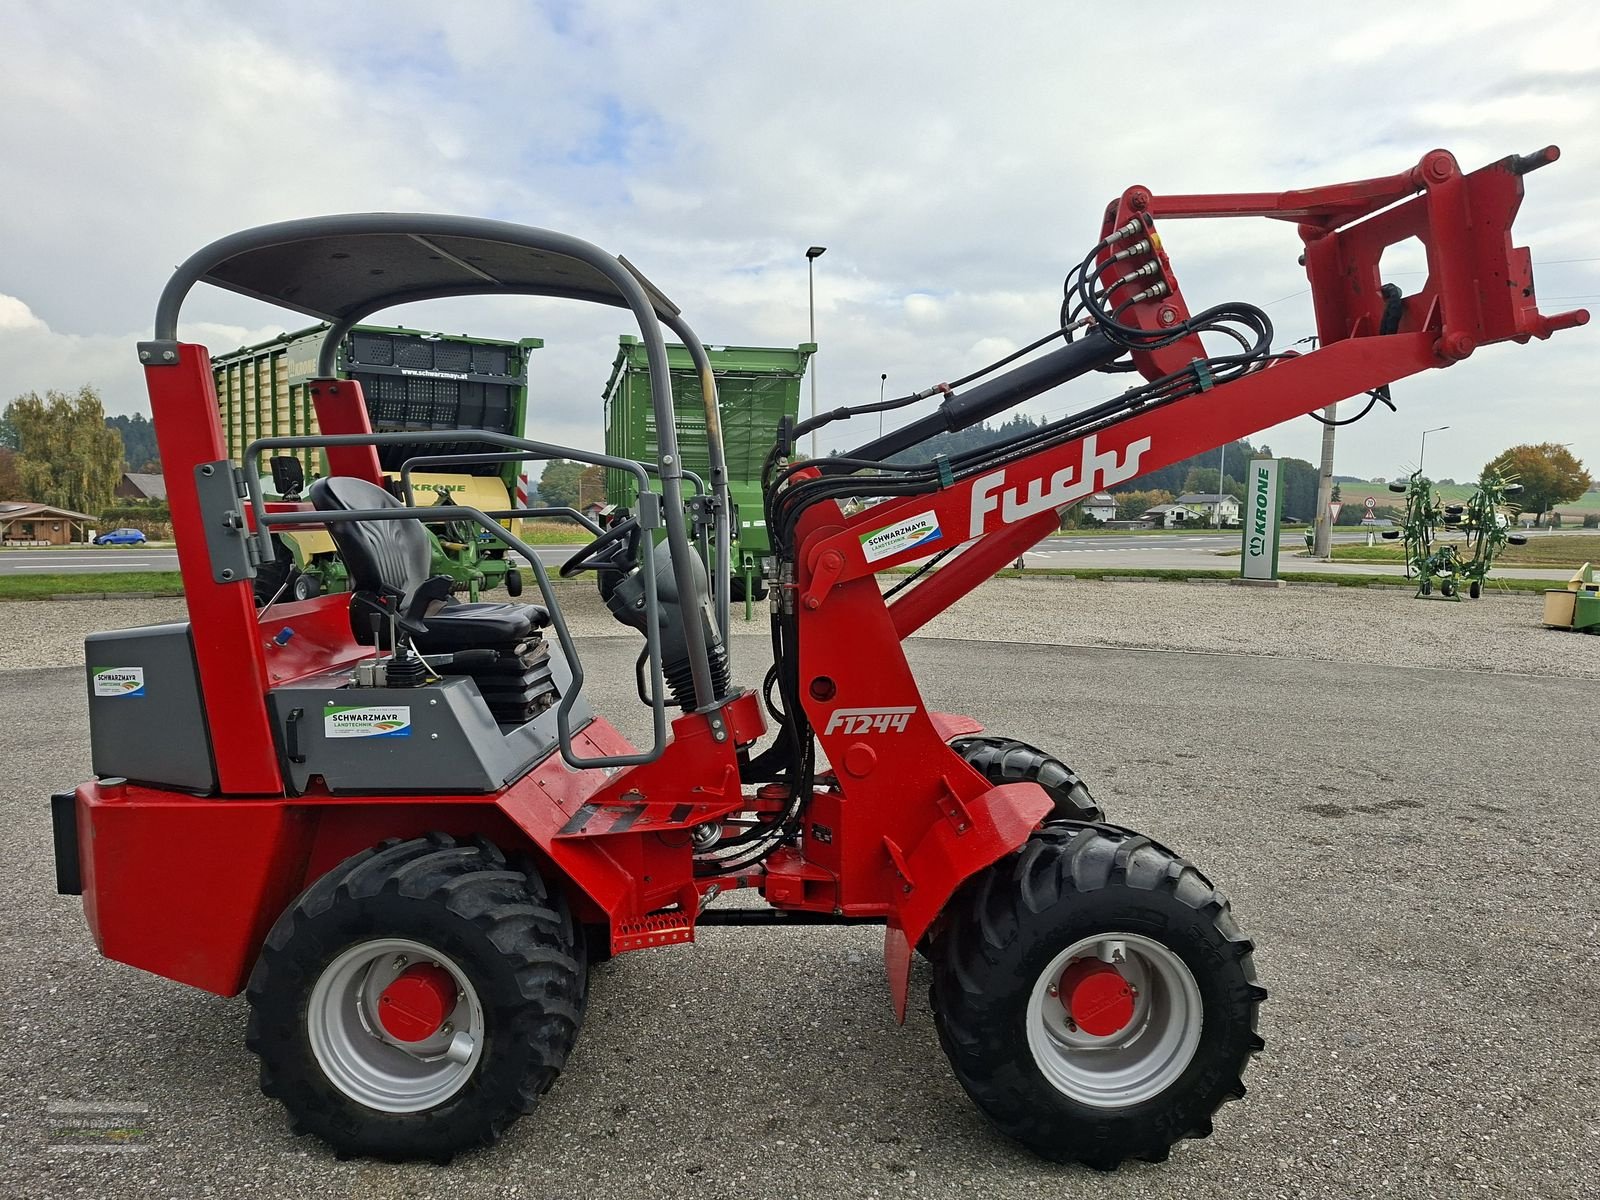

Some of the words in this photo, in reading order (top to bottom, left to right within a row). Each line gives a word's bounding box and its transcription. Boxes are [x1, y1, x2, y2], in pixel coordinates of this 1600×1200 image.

[969, 434, 1151, 539] Fuchs
[1254, 467, 1269, 536] KRONE
[868, 520, 927, 546] SCHWARZMAYR
[871, 536, 906, 551] LANDTECHNIK
[332, 714, 398, 722] SCHWARZMAYR
[823, 706, 917, 735] F1244
